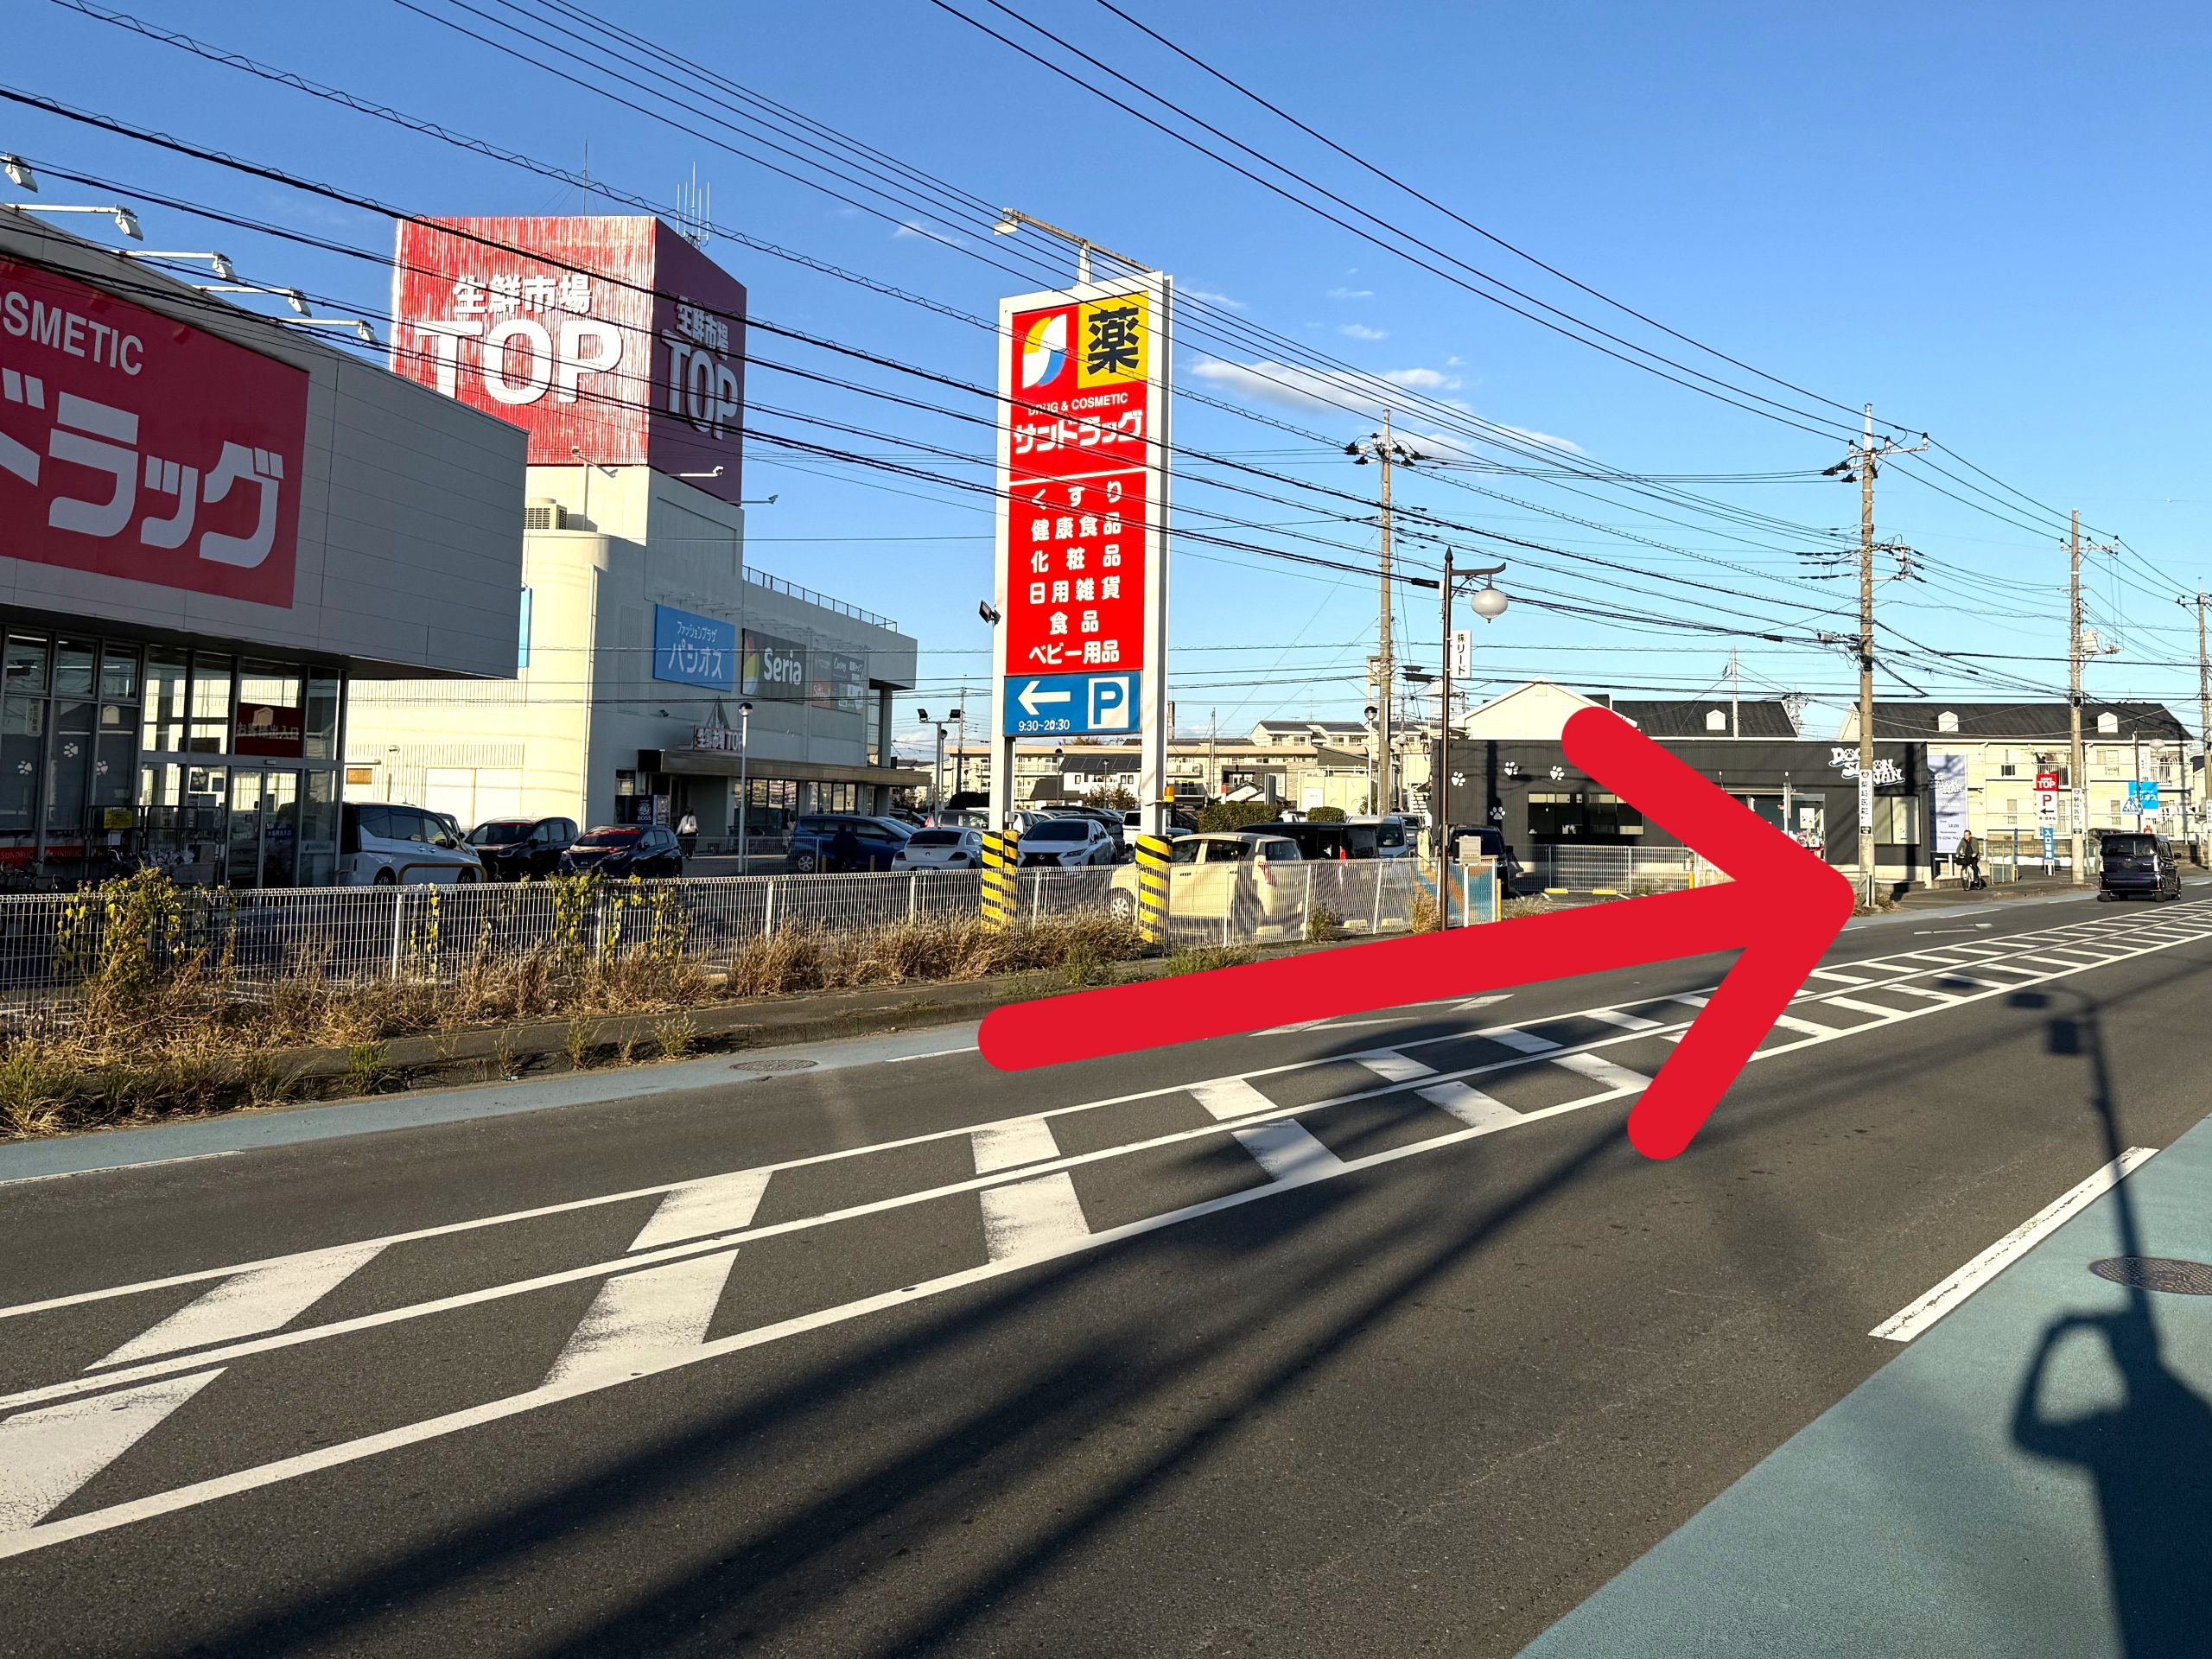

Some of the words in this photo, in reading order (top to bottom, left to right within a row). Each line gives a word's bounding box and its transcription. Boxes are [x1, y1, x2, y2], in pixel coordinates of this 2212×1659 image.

[453, 274, 593, 315] 生鮮市場
[0, 291, 143, 376] SMETIC
[676, 296, 729, 361] 生鮮市場
[1087, 307, 1140, 375] 薬
[416, 319, 624, 405] TOP
[659, 329, 740, 441] TOP
[1061, 401, 1069, 411] &
[1071, 392, 1128, 410] COSMETIC
[1014, 410, 1143, 454] サンドラッグ
[1031, 480, 1122, 510] くすり
[1031, 512, 1122, 542] 健康食品
[1031, 543, 1122, 573] 化粧品
[1029, 575, 1121, 605] 日用雑貨
[677, 620, 718, 643] ファッションプラザ
[1049, 610, 1099, 635] 食品
[668, 639, 723, 680] パシオス
[764, 647, 802, 686] Seria
[1028, 639, 1120, 664] ベビー用品
[1093, 681, 1124, 726] P
[2037, 780, 2056, 789] TOP
[2043, 794, 2052, 806] P
